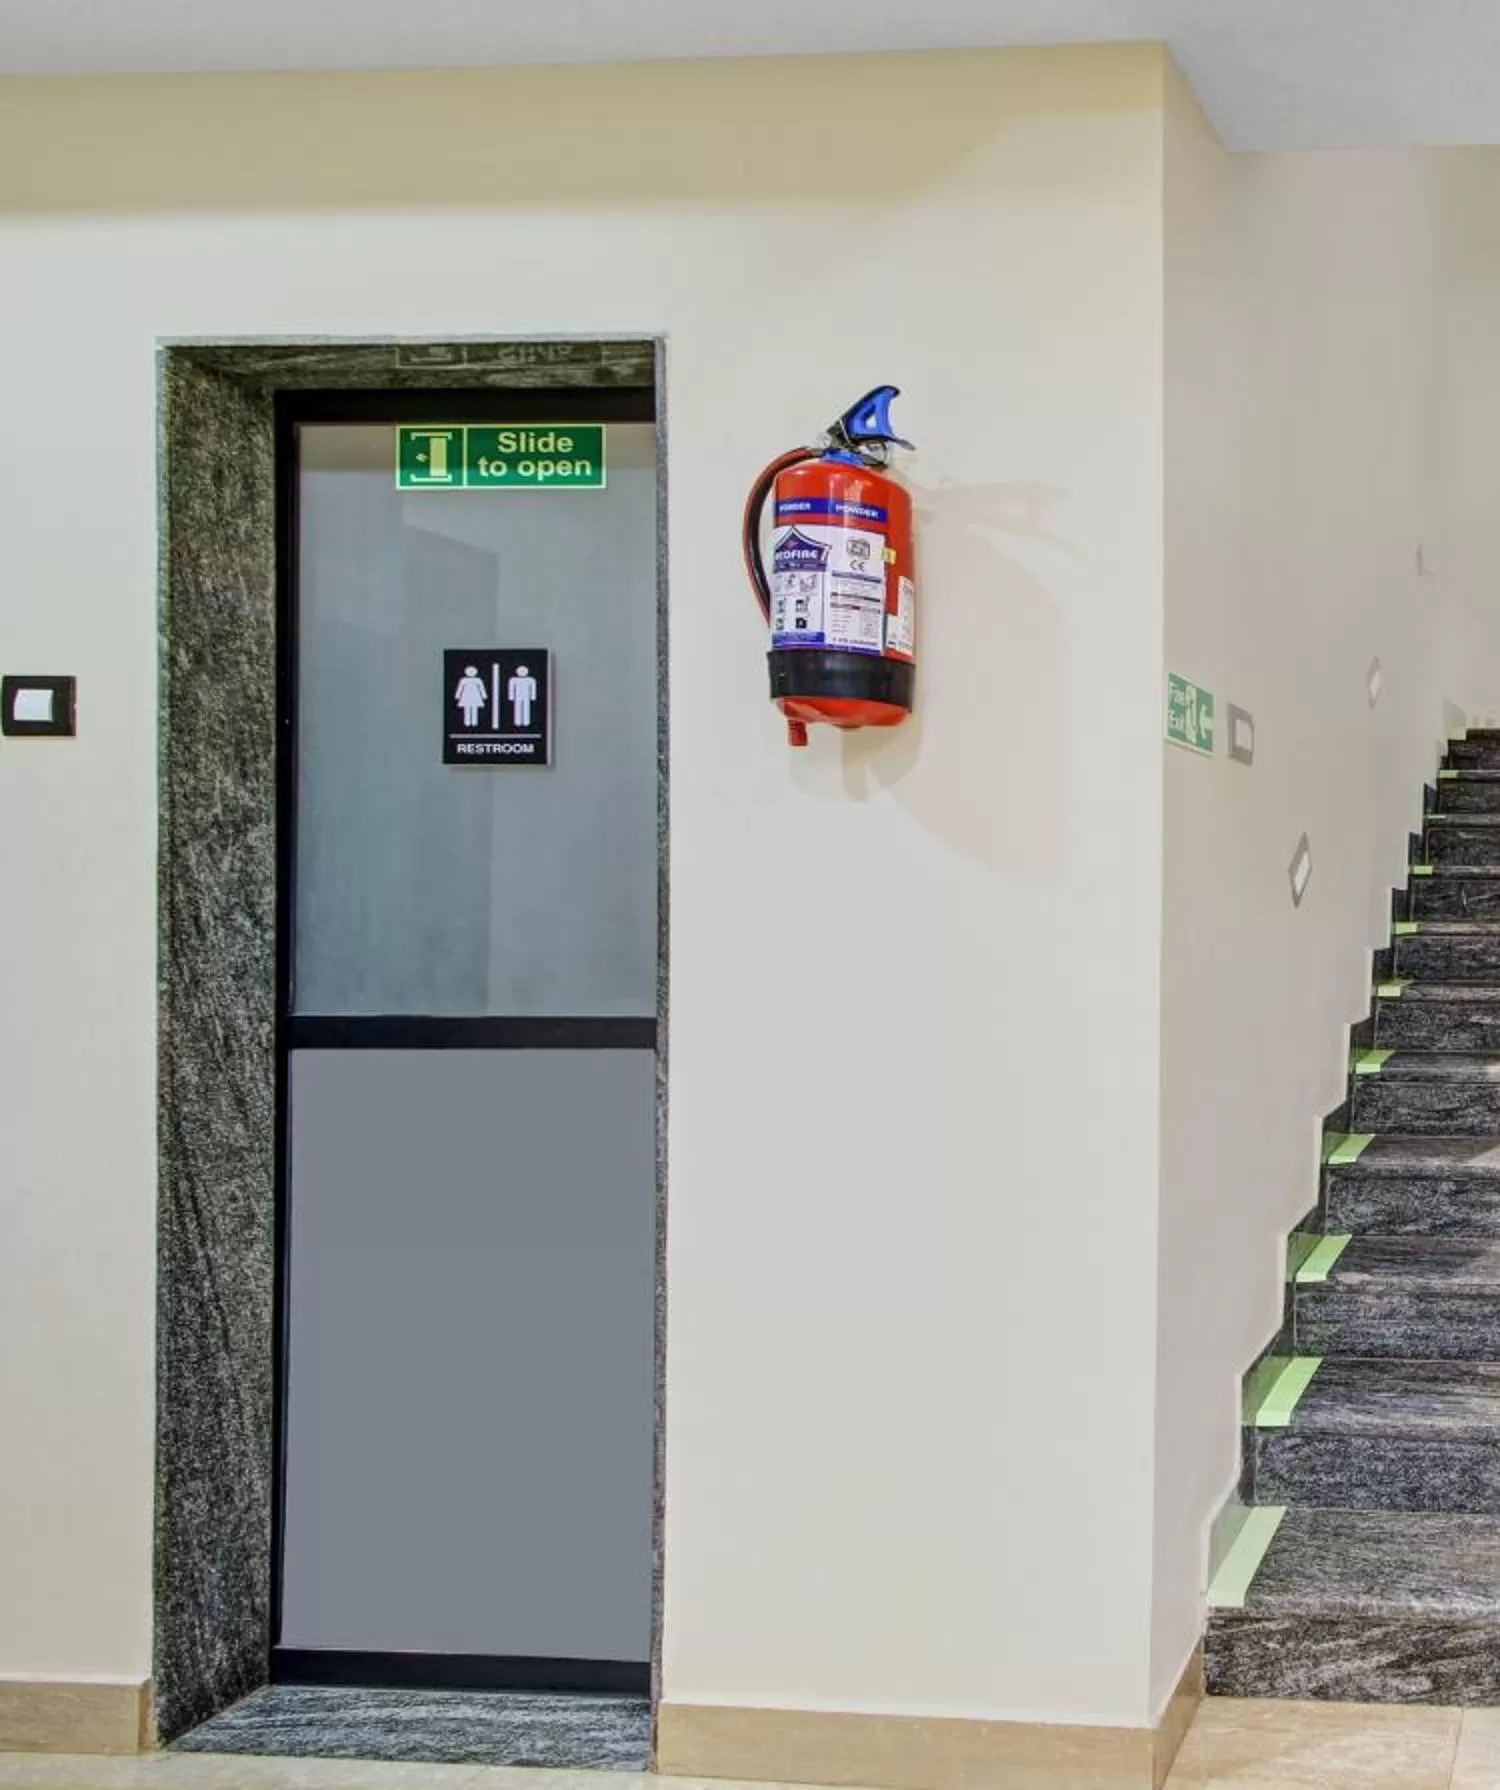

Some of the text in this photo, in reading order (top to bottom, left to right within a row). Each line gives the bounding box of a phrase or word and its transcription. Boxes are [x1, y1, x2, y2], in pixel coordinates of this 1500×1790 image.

[498, 431, 573, 453] Slide
[478, 456, 592, 481] to open
[836, 504, 879, 518] POWDER
[456, 743, 535, 754] RESTROOM
